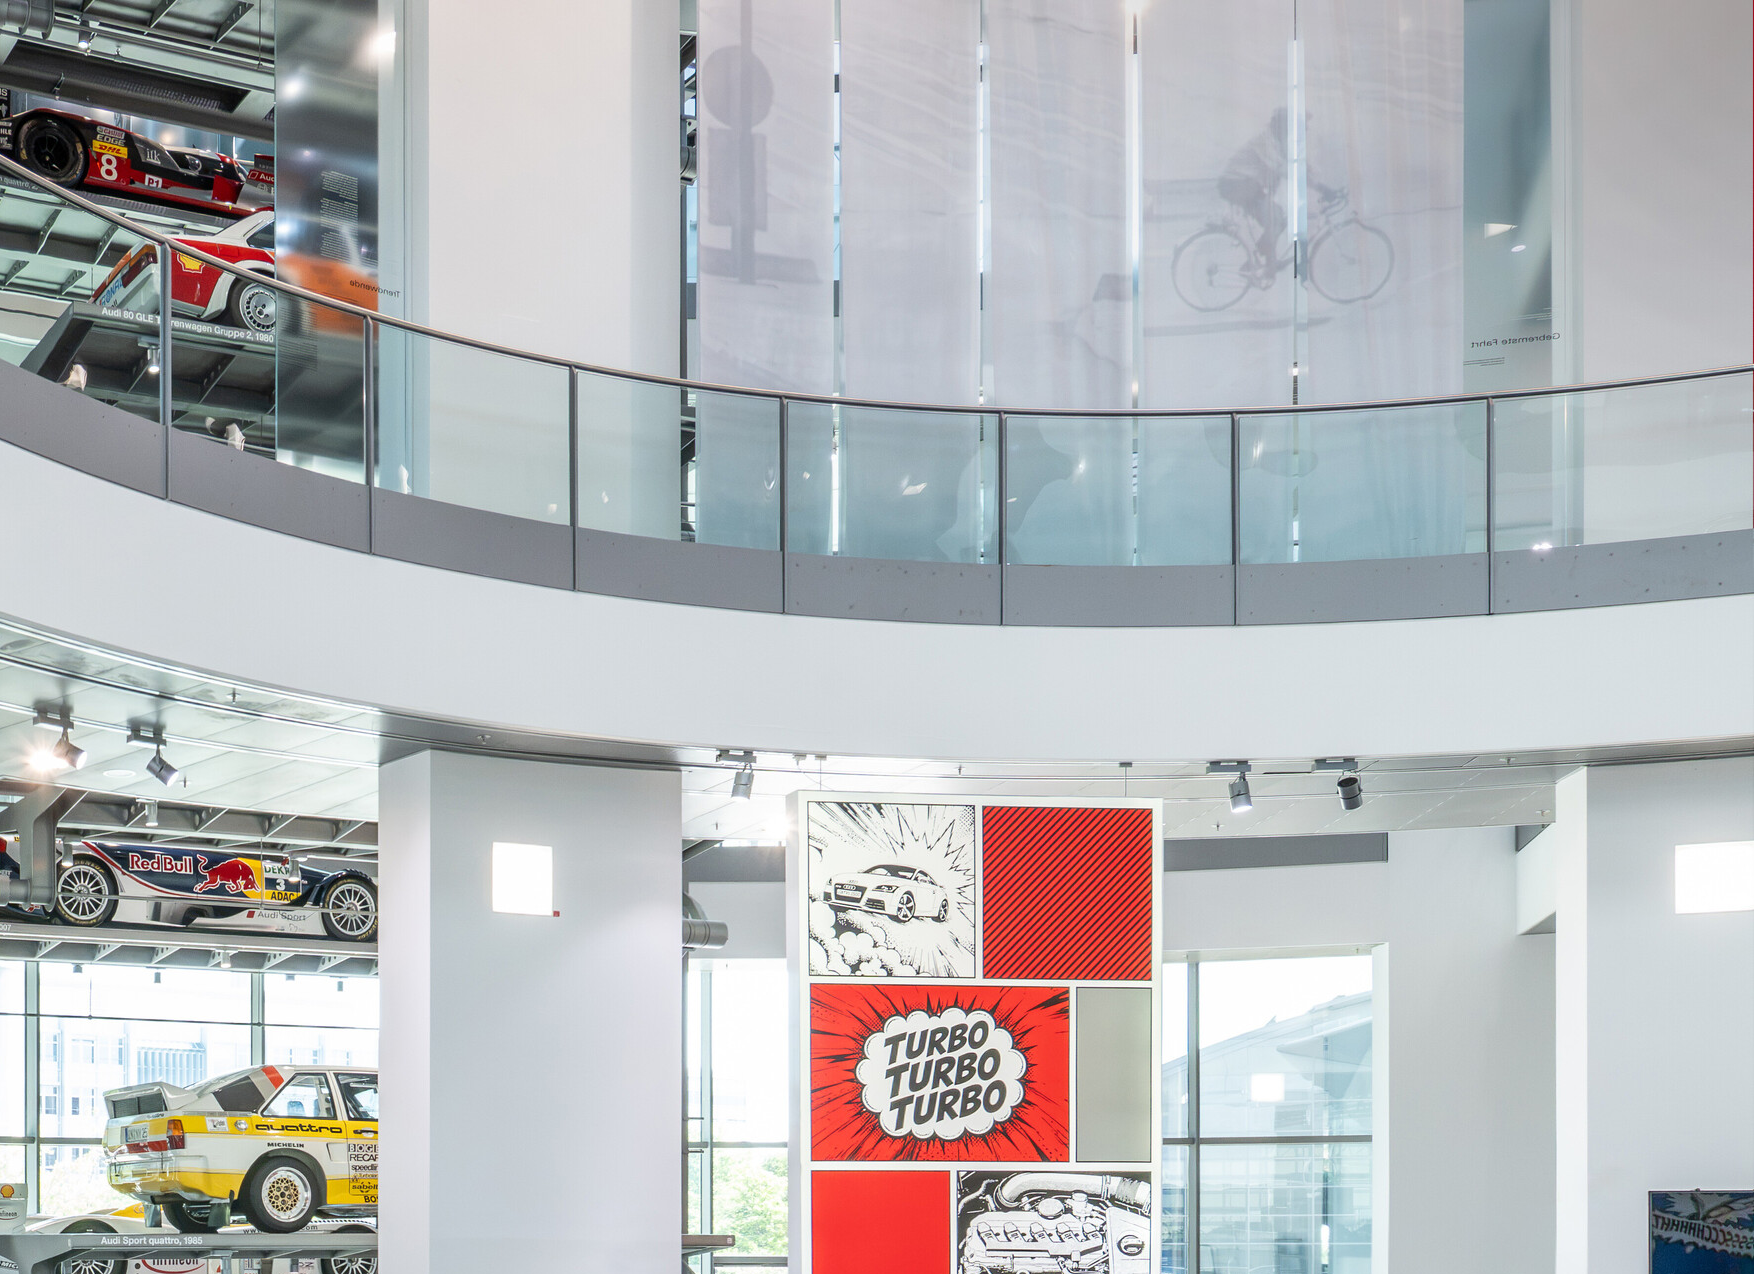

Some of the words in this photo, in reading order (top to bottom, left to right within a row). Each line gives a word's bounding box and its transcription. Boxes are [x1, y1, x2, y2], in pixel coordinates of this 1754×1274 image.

[96, 134, 126, 147] EDGE
[98, 143, 123, 155] DHL
[100, 154, 119, 181] 8
[4, 177, 31, 190] quattro,
[148, 174, 161, 188] P1
[101, 306, 122, 318] Audi
[123, 310, 135, 321] 80
[136, 312, 153, 323] GLE
[155, 315, 213, 335] Trenwagen
[214, 326, 245, 342] Gruppe
[246, 332, 254, 341] 2,
[255, 333, 274, 344] 1980
[129, 852, 161, 872] Red
[162, 854, 194, 874] Bull
[275, 878, 286, 891] 3
[270, 891, 295, 902] ADAC
[257, 910, 278, 919] Audi
[280, 911, 306, 921] Sport
[883, 1020, 989, 1066] TURBO
[884, 1048, 1001, 1099] TURBO
[889, 1079, 1007, 1131] TURBO
[255, 1123, 343, 1134] quattro
[100, 1235, 122, 1245] Audi
[123, 1235, 147, 1247] Sport
[148, 1236, 182, 1247] quattro,
[183, 1236, 203, 1245] 1985
